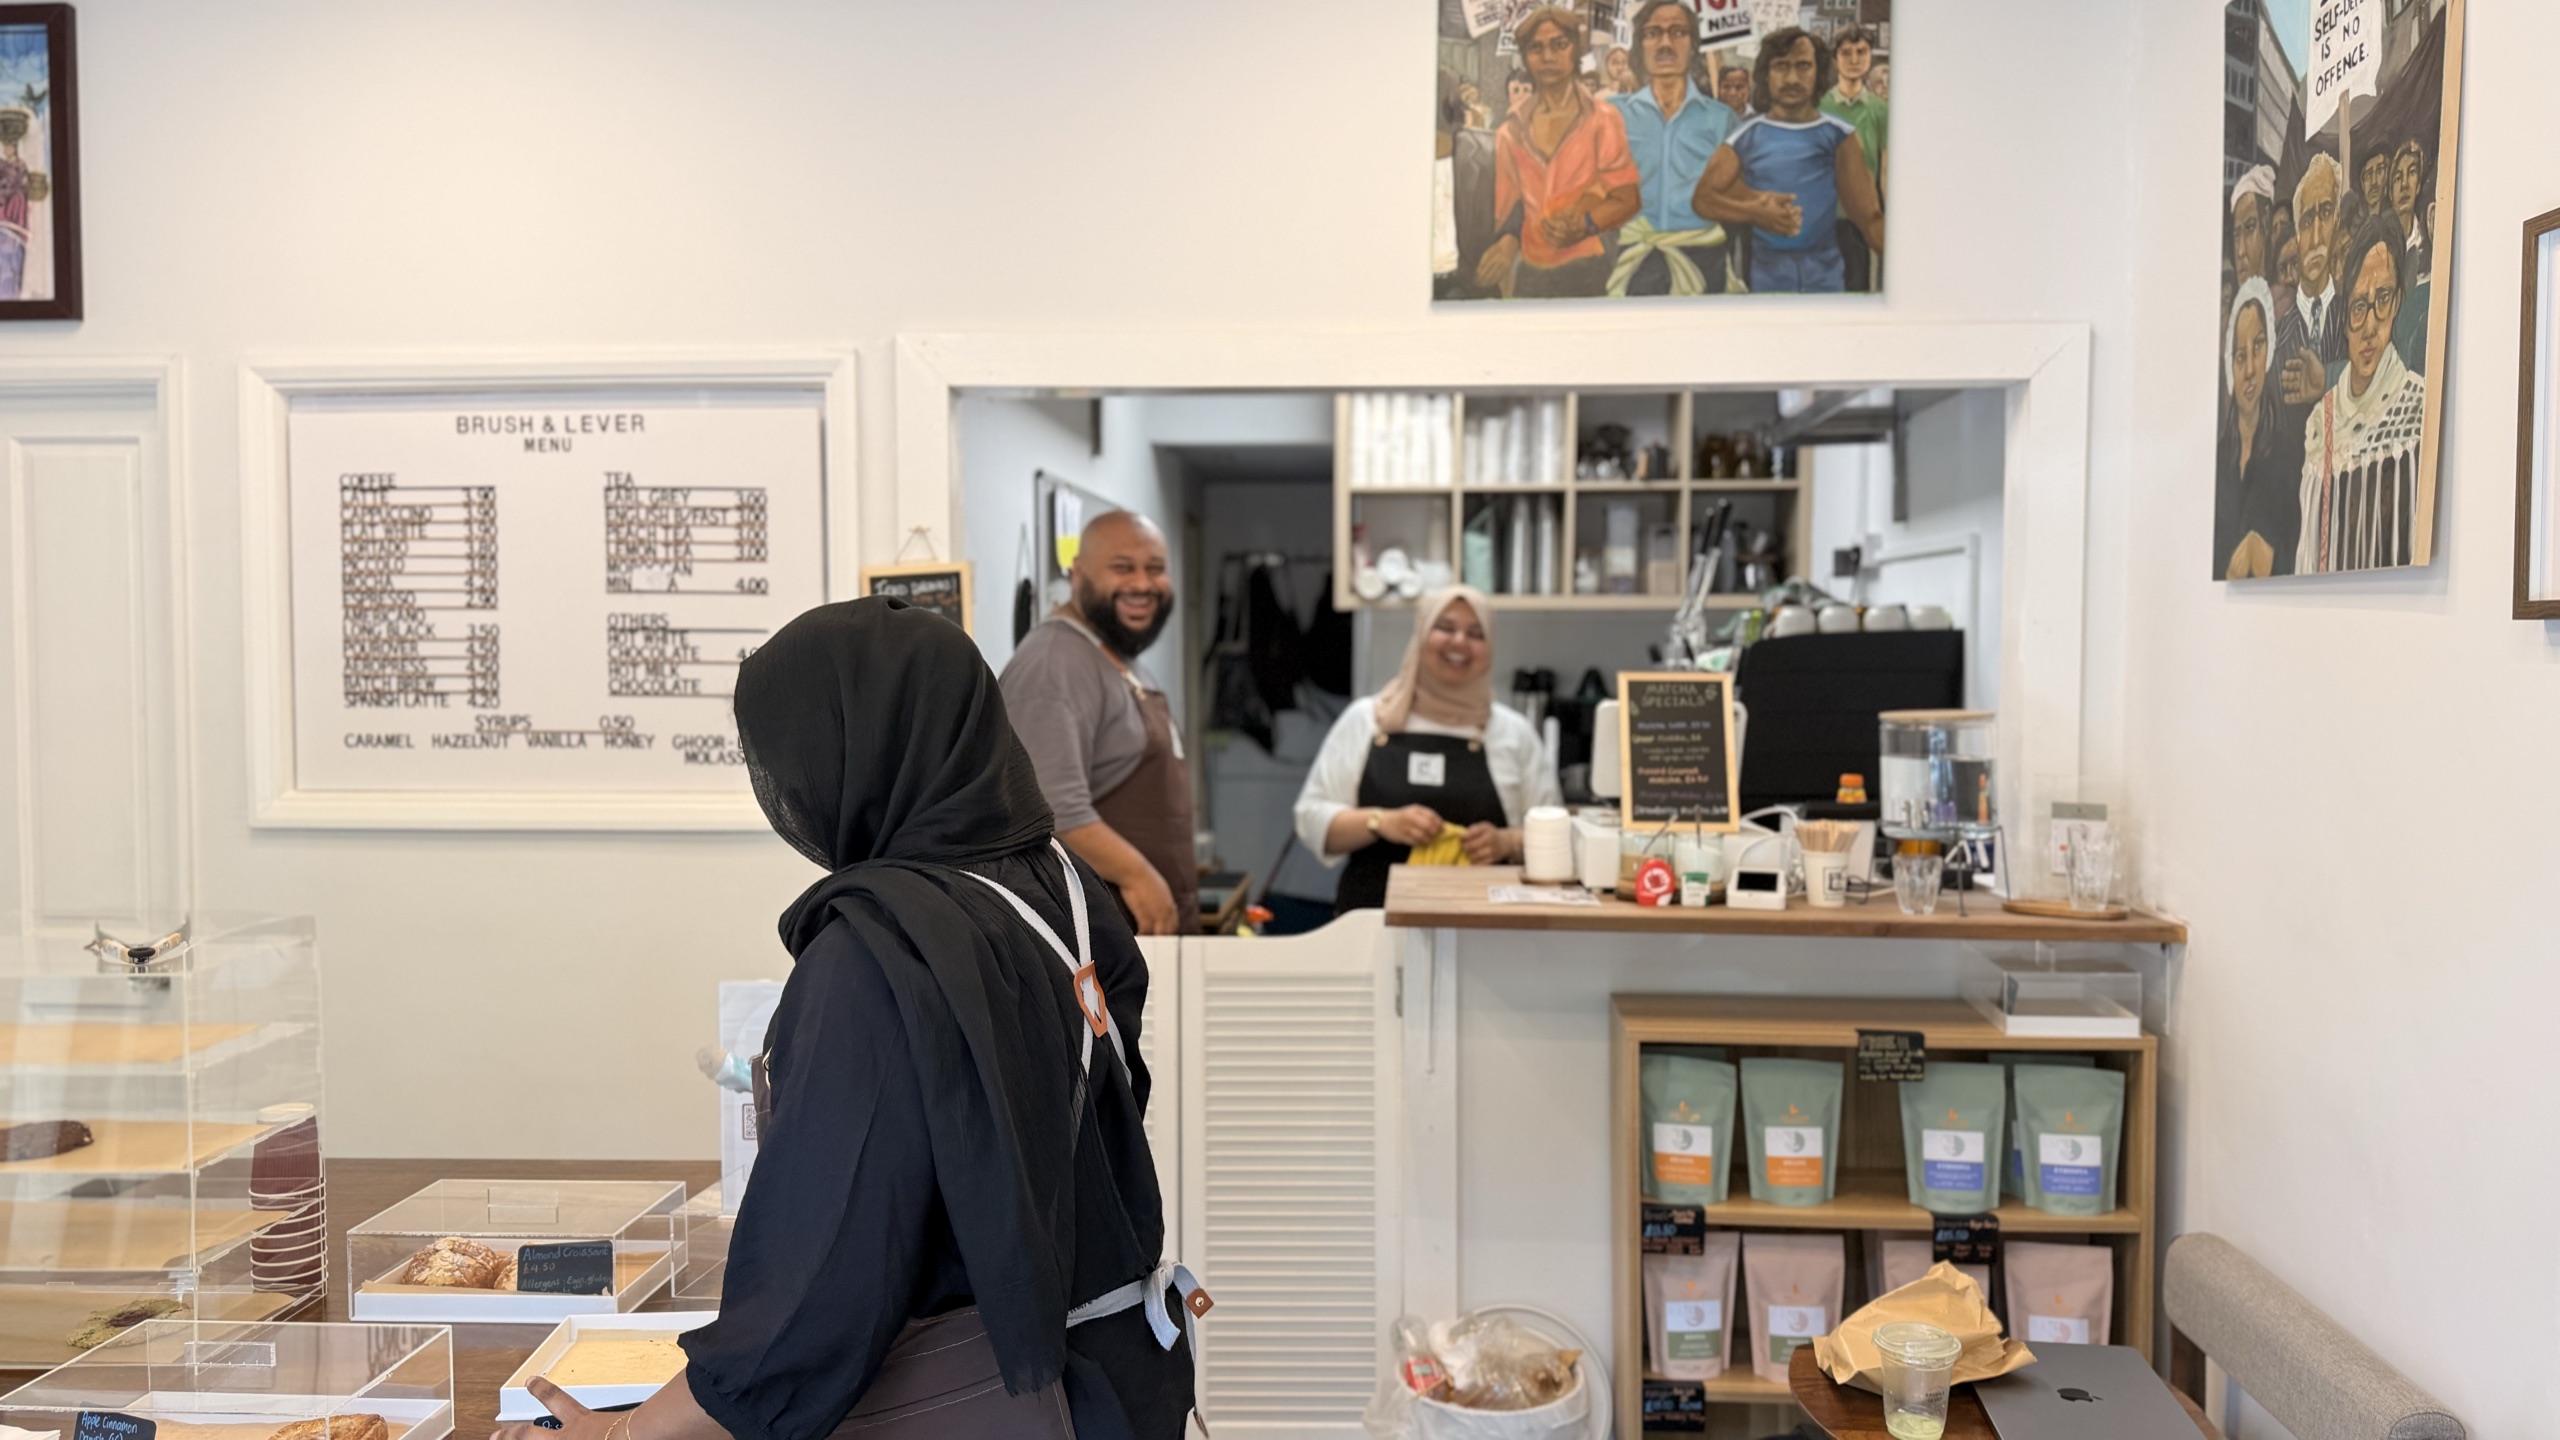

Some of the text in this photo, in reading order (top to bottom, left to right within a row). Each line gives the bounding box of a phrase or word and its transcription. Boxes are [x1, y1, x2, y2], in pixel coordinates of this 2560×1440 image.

[1708, 11, 1751, 32] NAZIS
[2321, 16, 2360, 62] IS NO
[2316, 42, 2369, 96] OFFENCE.
[456, 414, 645, 434] BRUSH & LEVER
[524, 437, 572, 452] MENU
[340, 474, 396, 489] COFFEE
[604, 472, 635, 488] TEA
[341, 488, 389, 506] LATTE
[605, 488, 643, 507] EARL
[650, 488, 691, 507] GREY
[606, 507, 669, 525] ENGLISH
[674, 508, 729, 526] B/FAST
[342, 523, 376, 541] FLAT
[384, 523, 428, 540] WHITE
[607, 525, 657, 543] PEACH
[661, 525, 693, 543] TEA
[341, 541, 409, 557] CORTADO
[607, 542, 657, 560] LEMON
[661, 543, 693, 561] TEA
[343, 557, 405, 574] PICCOLO
[343, 574, 395, 591] MOCHA
[735, 577, 768, 594] 4.00
[343, 591, 416, 608] ESPRESSO
[343, 608, 427, 625] AMERICANO
[607, 613, 669, 629] OTHERS
[343, 622, 381, 640] LONG
[387, 623, 437, 640] BLACK
[608, 630, 690, 646] HOT WHITE
[608, 647, 701, 663] CHOCOLATE
[343, 657, 428, 675] AEROPRESS
[608, 663, 680, 679] HOT MILK
[344, 675, 392, 692] BATCH
[397, 675, 437, 692] BREW
[608, 679, 701, 694] CHOCOLATE
[404, 692, 450, 709] LATTE
[475, 714, 635, 730] SYRUPS 0.50
[344, 734, 415, 749] CARAMEL
[432, 734, 511, 749] HAZELNUT
[527, 734, 587, 749] VANILLA
[604, 734, 655, 749] HONEY
[684, 751, 746, 765] MOLASS
[522, 1245, 609, 1261] Almond Croissant
[82, 1411, 138, 1434] Apple Cinnamon
